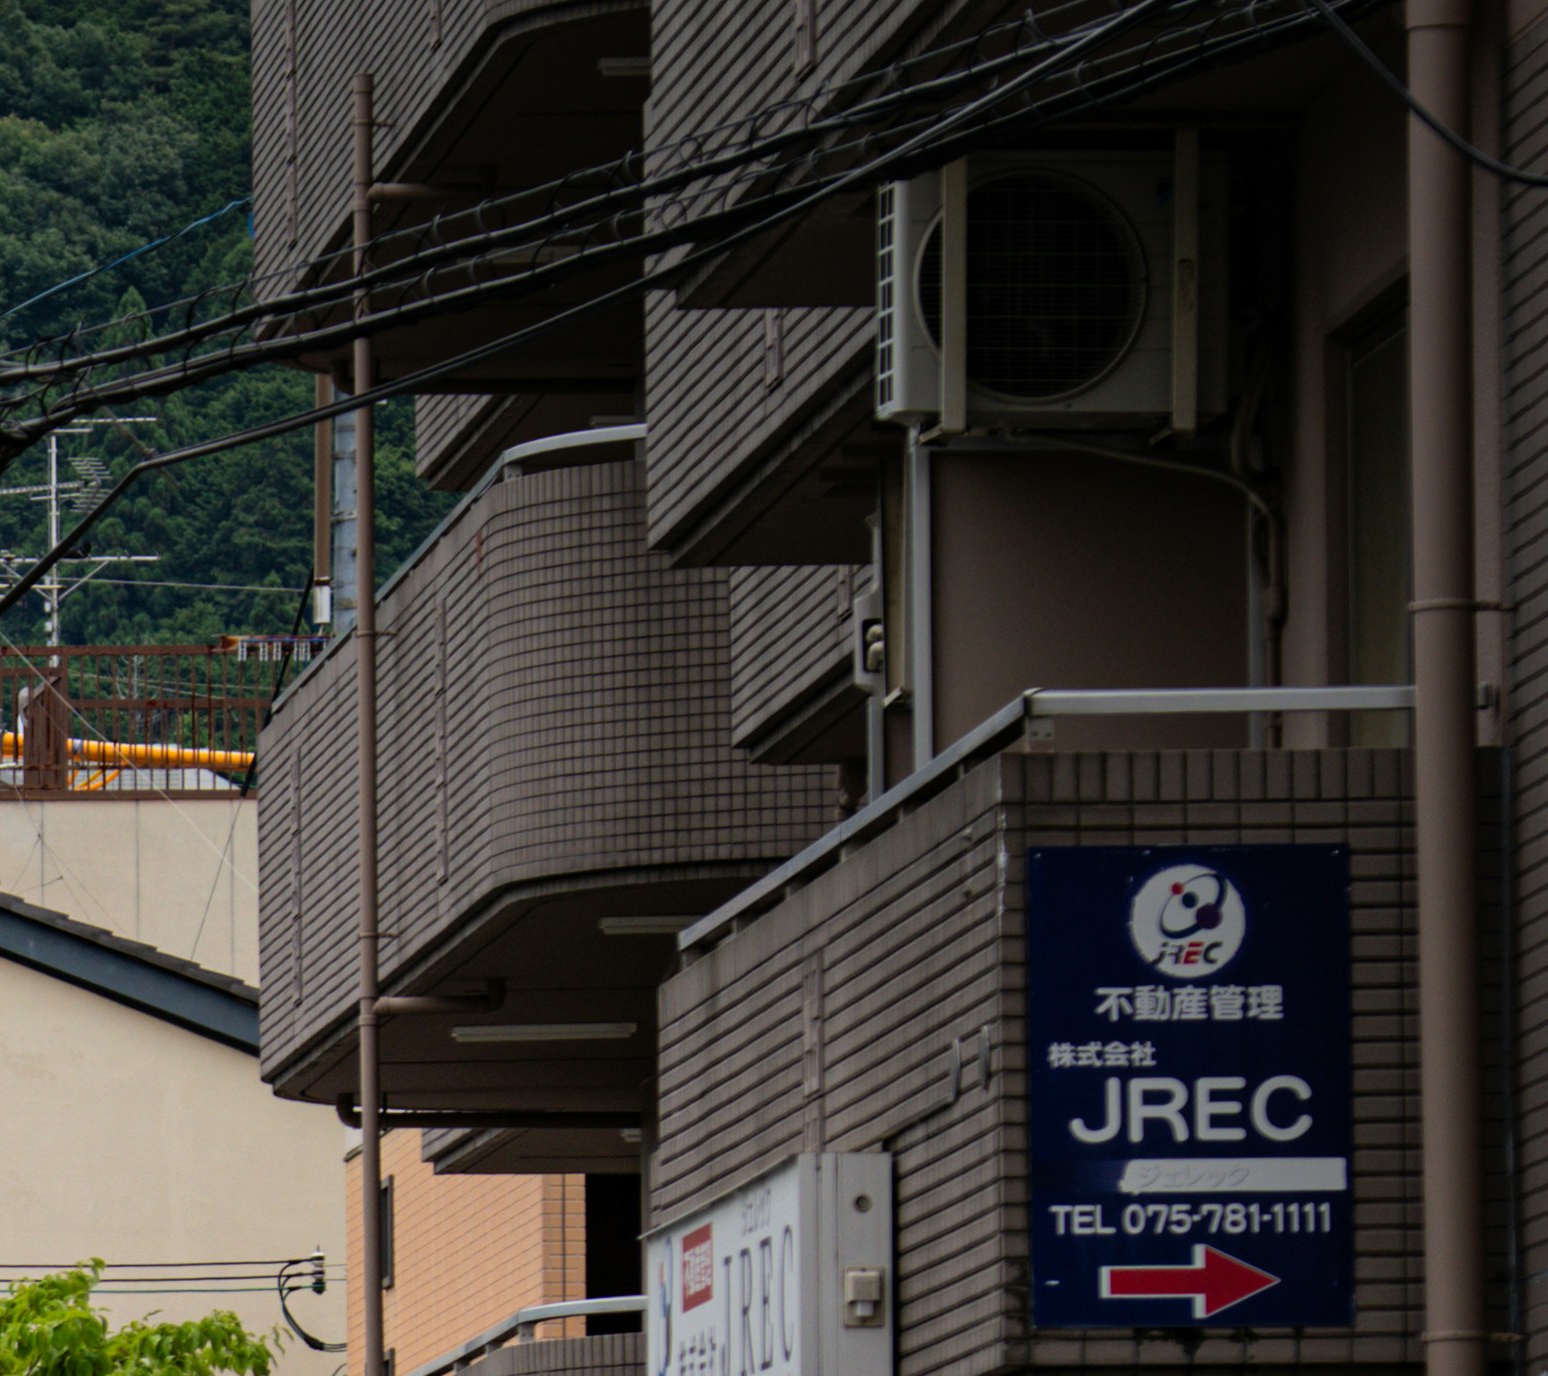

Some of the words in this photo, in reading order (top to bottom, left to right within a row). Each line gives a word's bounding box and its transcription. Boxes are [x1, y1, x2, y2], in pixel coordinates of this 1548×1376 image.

[1094, 985, 1284, 1022] 不動産管理
[1046, 1041, 1157, 1068] 株式会社
[1069, 1075, 1314, 1143] JREC
[1047, 1204, 1116, 1235] TEL
[1122, 1202, 1332, 1235] 075-781-1111
